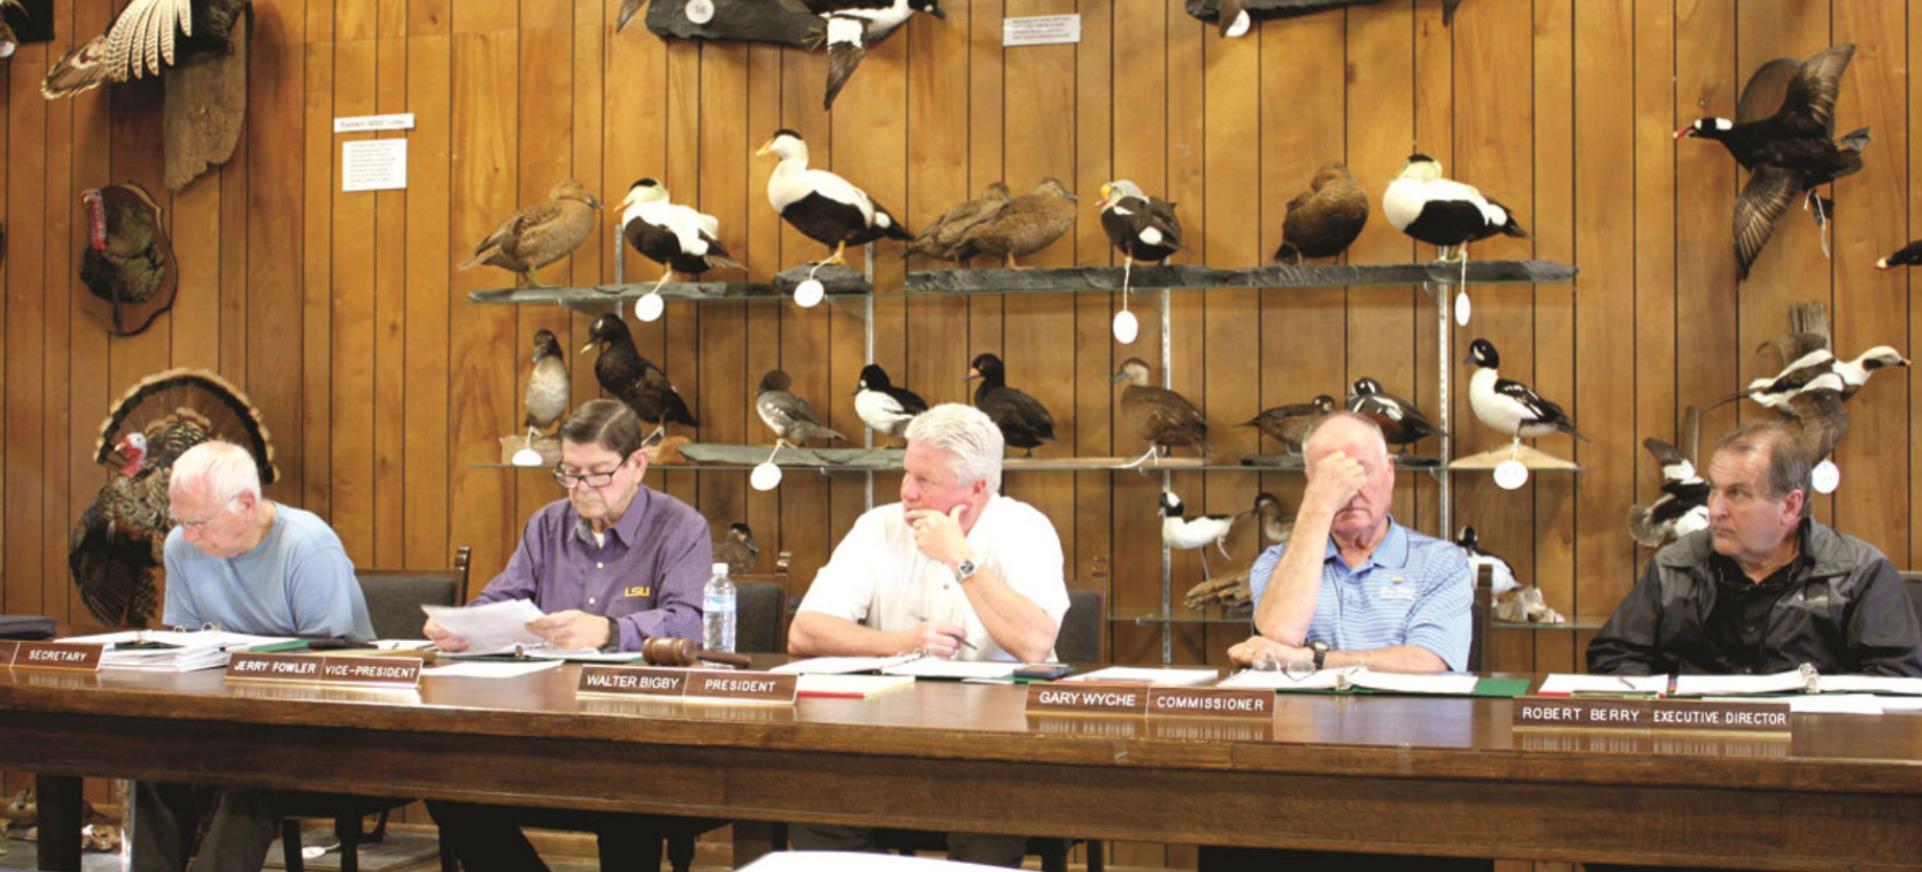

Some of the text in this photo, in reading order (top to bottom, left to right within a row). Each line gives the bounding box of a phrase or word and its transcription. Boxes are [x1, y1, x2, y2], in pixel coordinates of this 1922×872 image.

[624, 586, 650, 597] LSU
[28, 649, 88, 661] SECRETARY
[234, 660, 417, 678] JERRY FOWLER VICE-PRESIDENT
[587, 674, 775, 693] WALTER BIGBY PRESIDENT
[1039, 691, 1264, 712] GARY WYCHE COMMISSIONER
[1522, 706, 1787, 725] ROBERT BERRY EXECUTIVE DIRECTOR
